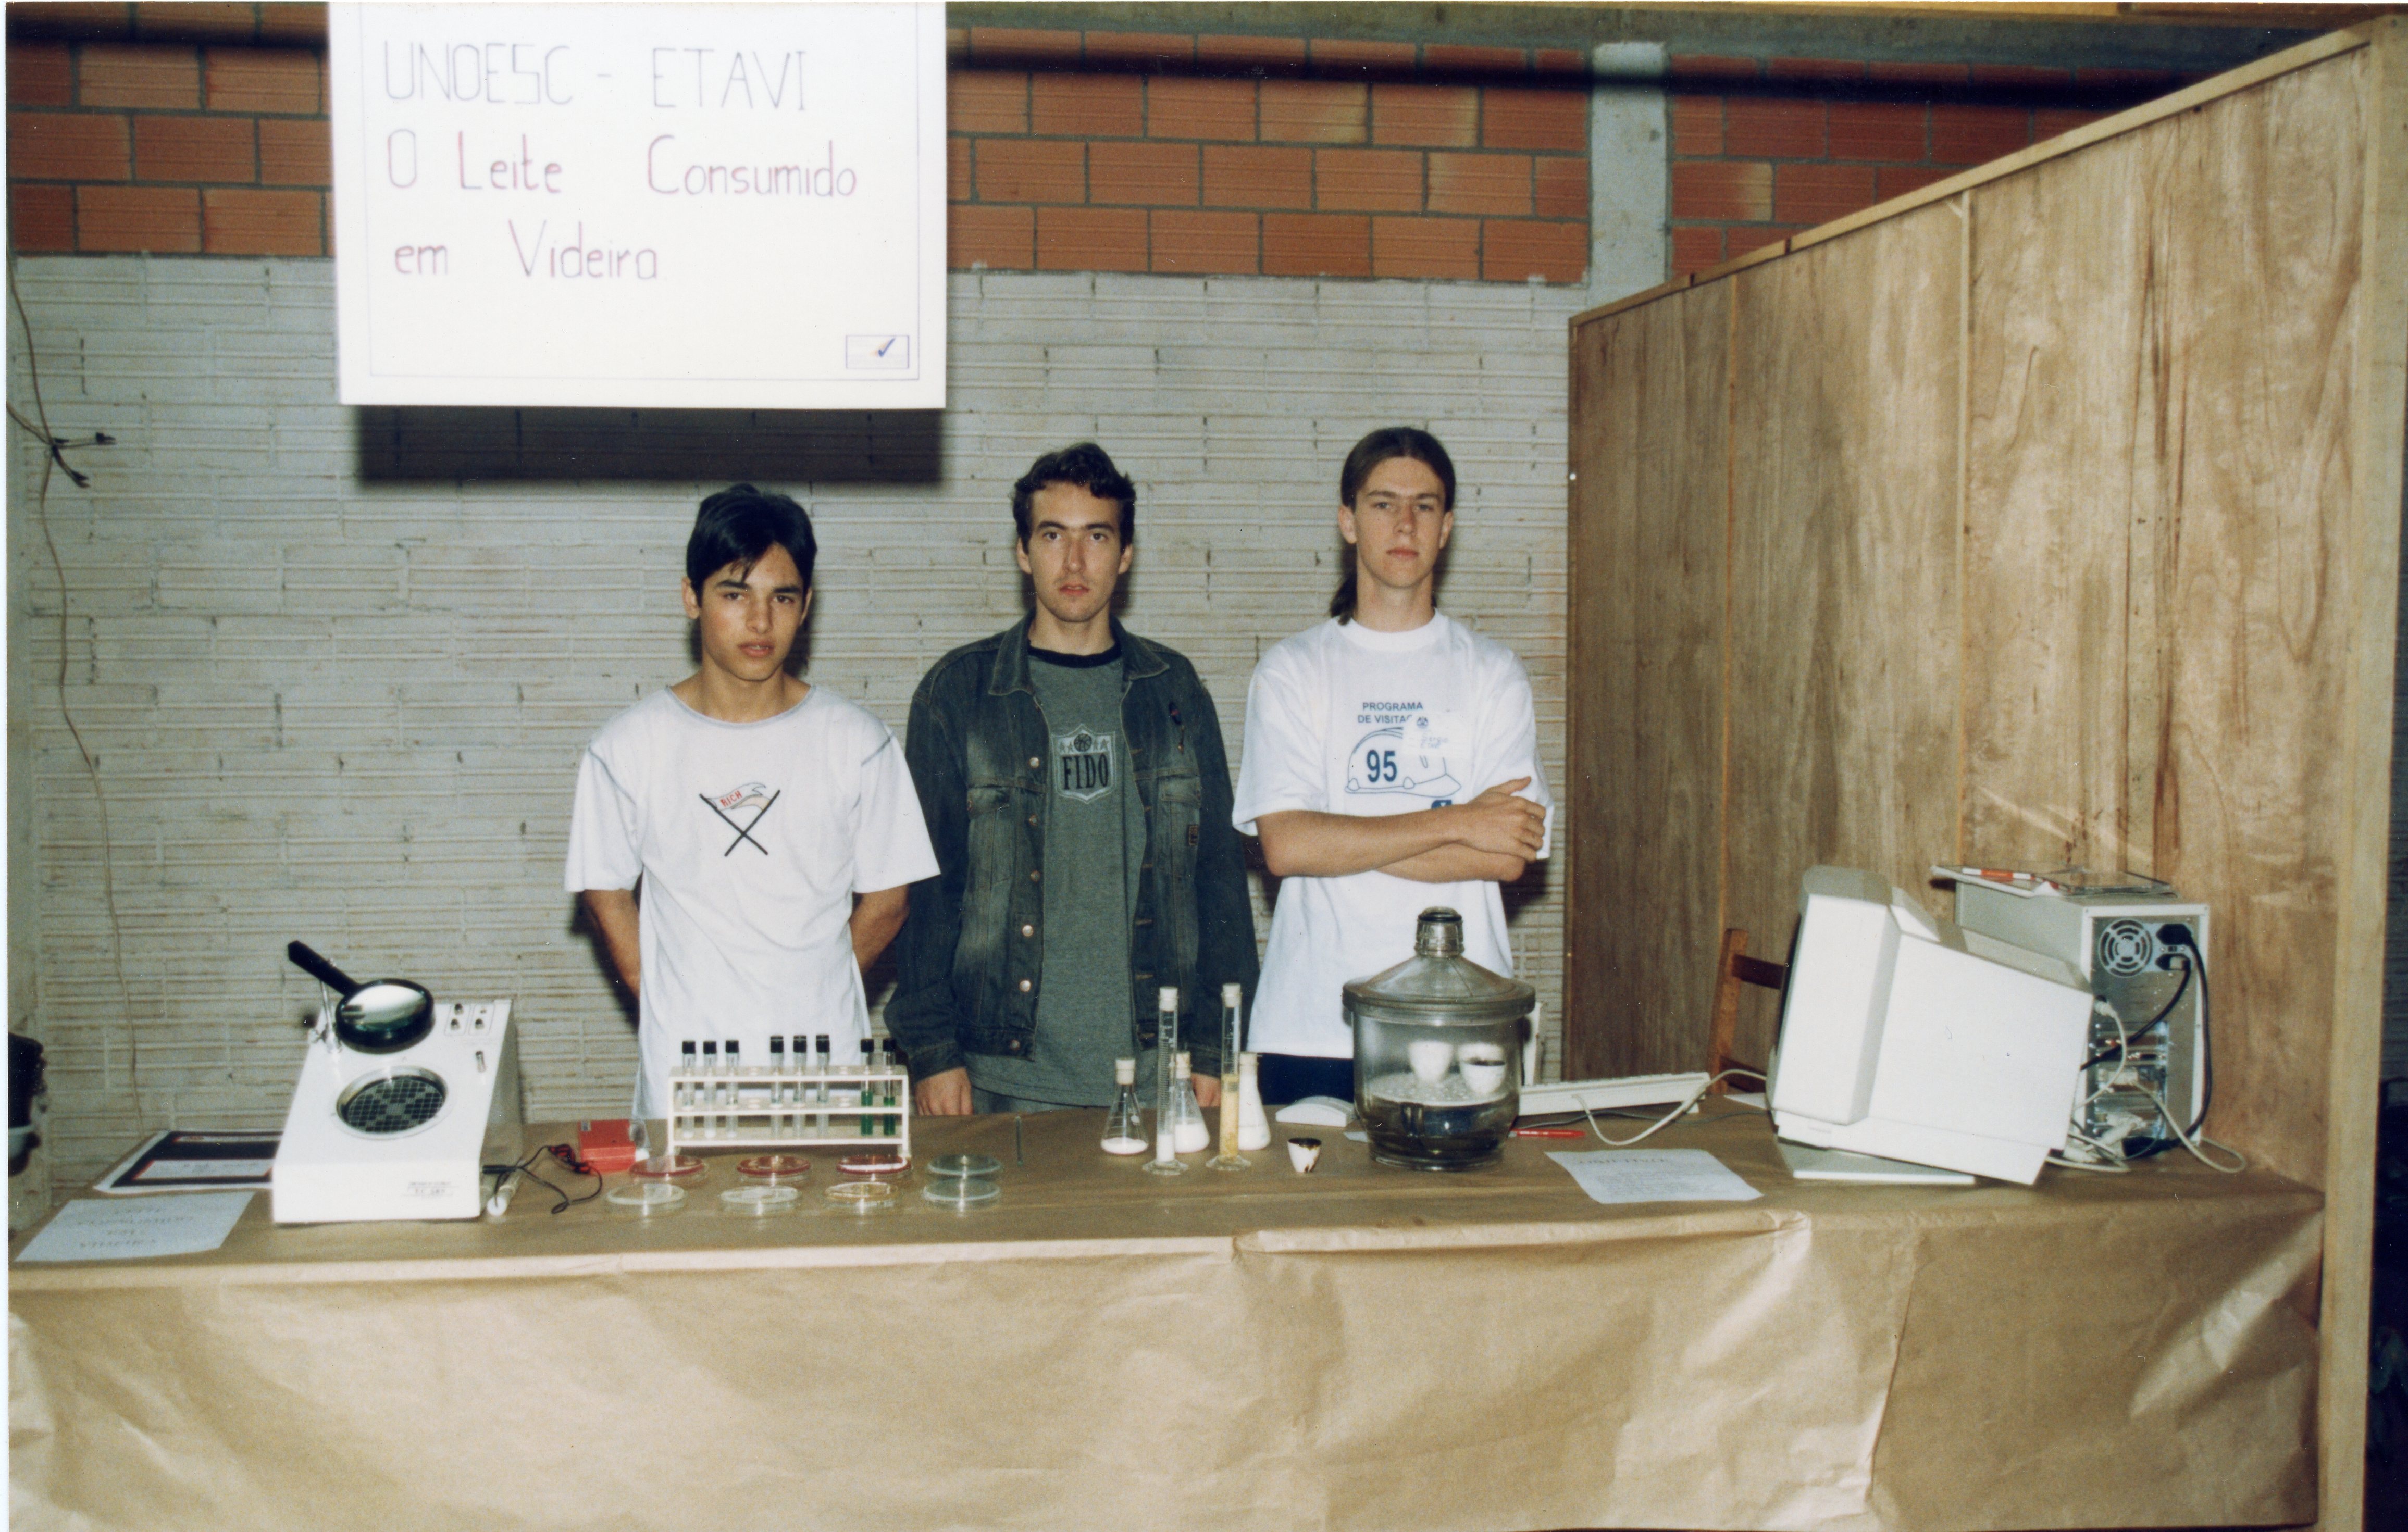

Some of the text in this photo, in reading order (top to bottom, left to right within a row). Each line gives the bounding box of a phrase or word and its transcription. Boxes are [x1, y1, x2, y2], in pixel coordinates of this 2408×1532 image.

[383, 40, 573, 106] UNOESC
[651, 46, 806, 111] ETAVI
[386, 128, 858, 198] O Leite Consumido
[393, 218, 659, 281] em Videira
[1357, 714, 1371, 724] DE
[1362, 702, 1424, 712] PROGRAMA
[1061, 753, 1109, 790] FIDO
[1366, 749, 1398, 783] 95
[719, 790, 742, 807] RICH
